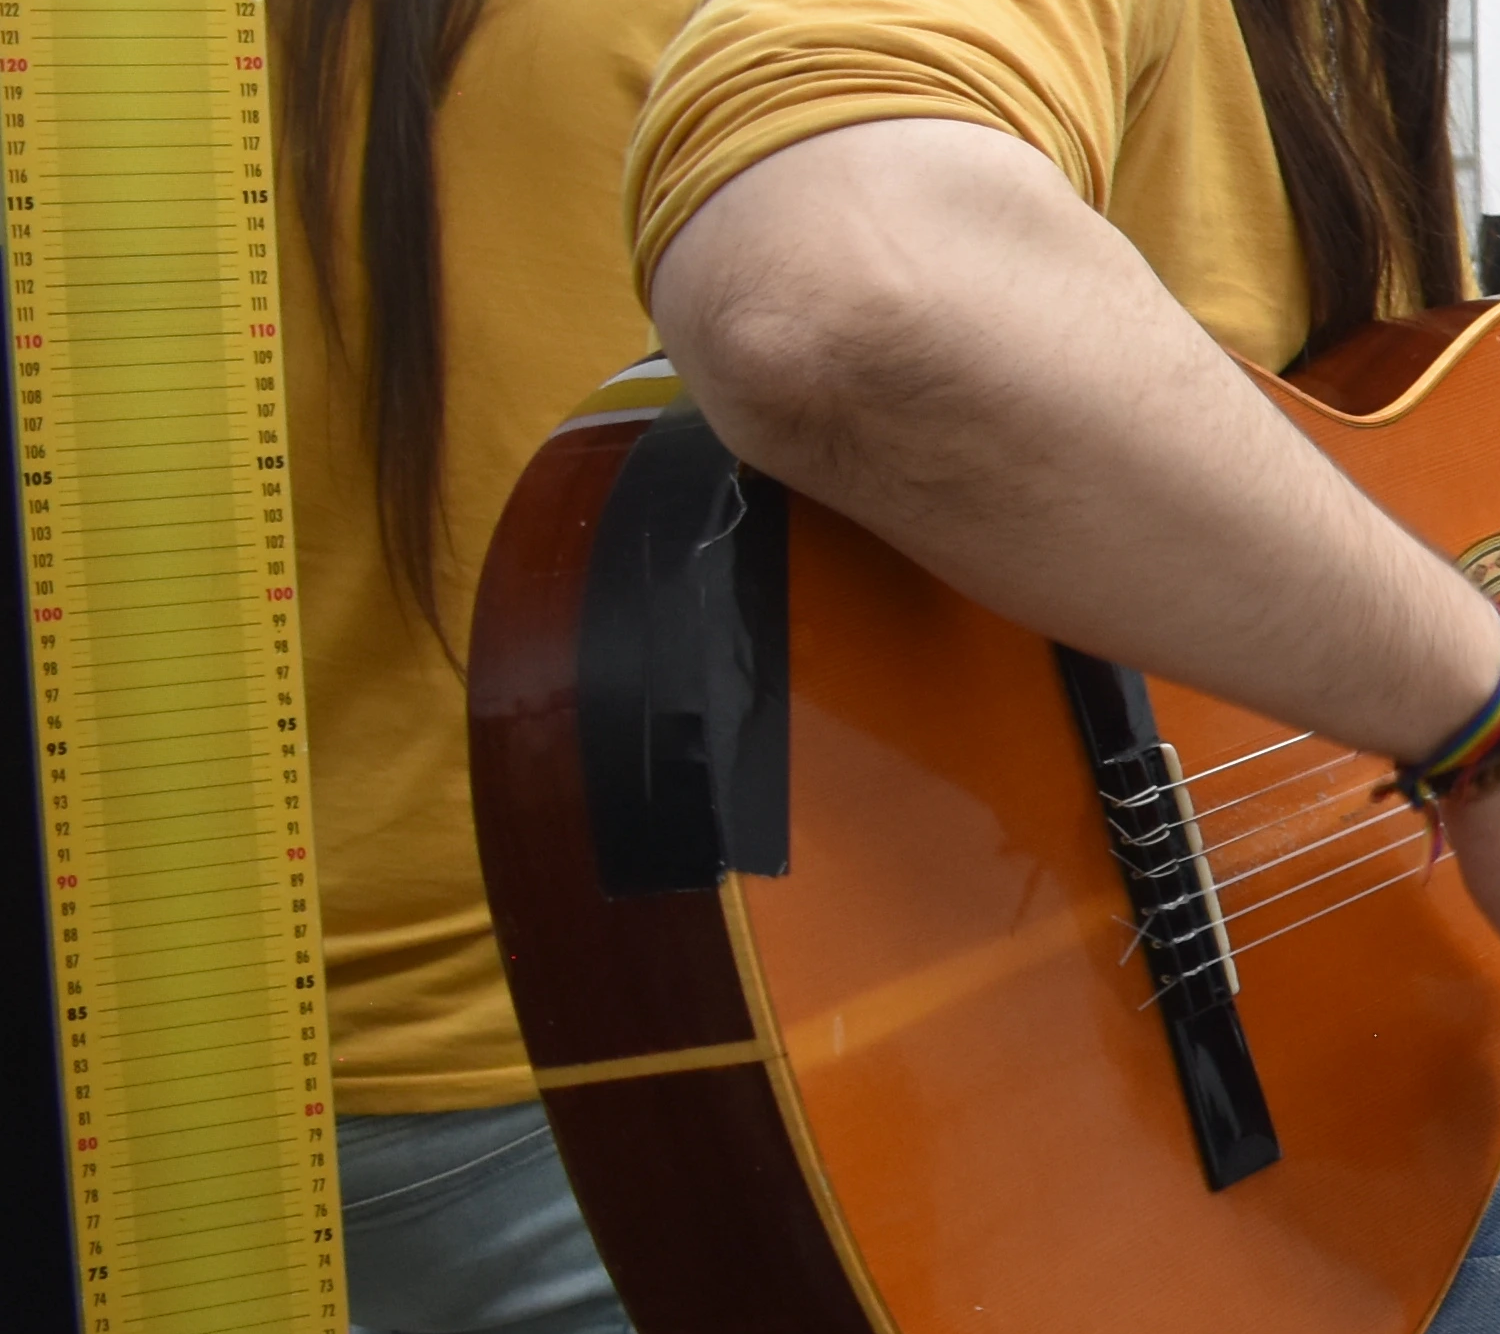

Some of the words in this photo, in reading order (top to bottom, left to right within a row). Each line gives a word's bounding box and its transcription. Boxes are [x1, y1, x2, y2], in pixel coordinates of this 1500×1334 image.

[235, 2, 256, 17] 122
[237, 28, 255, 44] 121
[234, 55, 264, 71] 120
[239, 82, 259, 97] 119
[241, 109, 260, 125] 118
[242, 135, 261, 151] 117
[243, 163, 263, 178] 116
[6, 195, 35, 211] 115
[242, 189, 269, 205] 115
[246, 216, 266, 231] 114
[248, 243, 267, 259] 113
[249, 269, 268, 285] 112
[250, 296, 268, 312] 111
[249, 323, 277, 338] 110
[14, 334, 43, 350] 110
[253, 349, 274, 365] 109
[254, 376, 276, 392] 108
[256, 402, 276, 419] 107
[257, 429, 279, 445] 106
[256, 454, 285, 471] 105
[22, 470, 53, 487] 105
[261, 482, 282, 497] 104
[263, 507, 284, 524] 103
[264, 534, 285, 550] 102
[266, 560, 285, 576] 101
[265, 586, 294, 602] 100
[33, 606, 63, 623] 100
[271, 613, 287, 628] 99
[273, 639, 290, 654] 98
[275, 664, 290, 680] 97
[277, 691, 293, 706] 96
[276, 717, 298, 733] 95
[45, 741, 68, 757] 95
[281, 743, 296, 758] 94
[282, 768, 298, 784] 93
[283, 794, 300, 810] 92
[286, 820, 301, 836] 91
[285, 846, 307, 862] 90
[56, 874, 78, 890] 90
[289, 872, 305, 888] 89
[291, 898, 307, 914] 88
[293, 923, 309, 939] 87
[294, 949, 310, 965] 86
[294, 973, 316, 990] 85
[66, 1005, 88, 1022] 85
[298, 1000, 314, 1016] 84
[300, 1025, 316, 1042] 83
[302, 1051, 318, 1067] 82
[304, 1076, 318, 1093] 81
[304, 1101, 325, 1118] 80
[308, 1127, 323, 1143] 79
[76, 1136, 99, 1153] 80
[310, 1152, 325, 1168] 78
[312, 1177, 326, 1193] 77
[314, 1203, 329, 1218] 76
[313, 1227, 334, 1244] 75
[318, 1253, 332, 1268] 74
[87, 1265, 109, 1282] 75
[320, 1278, 334, 1293] 73
[322, 1303, 336, 1318] 72
